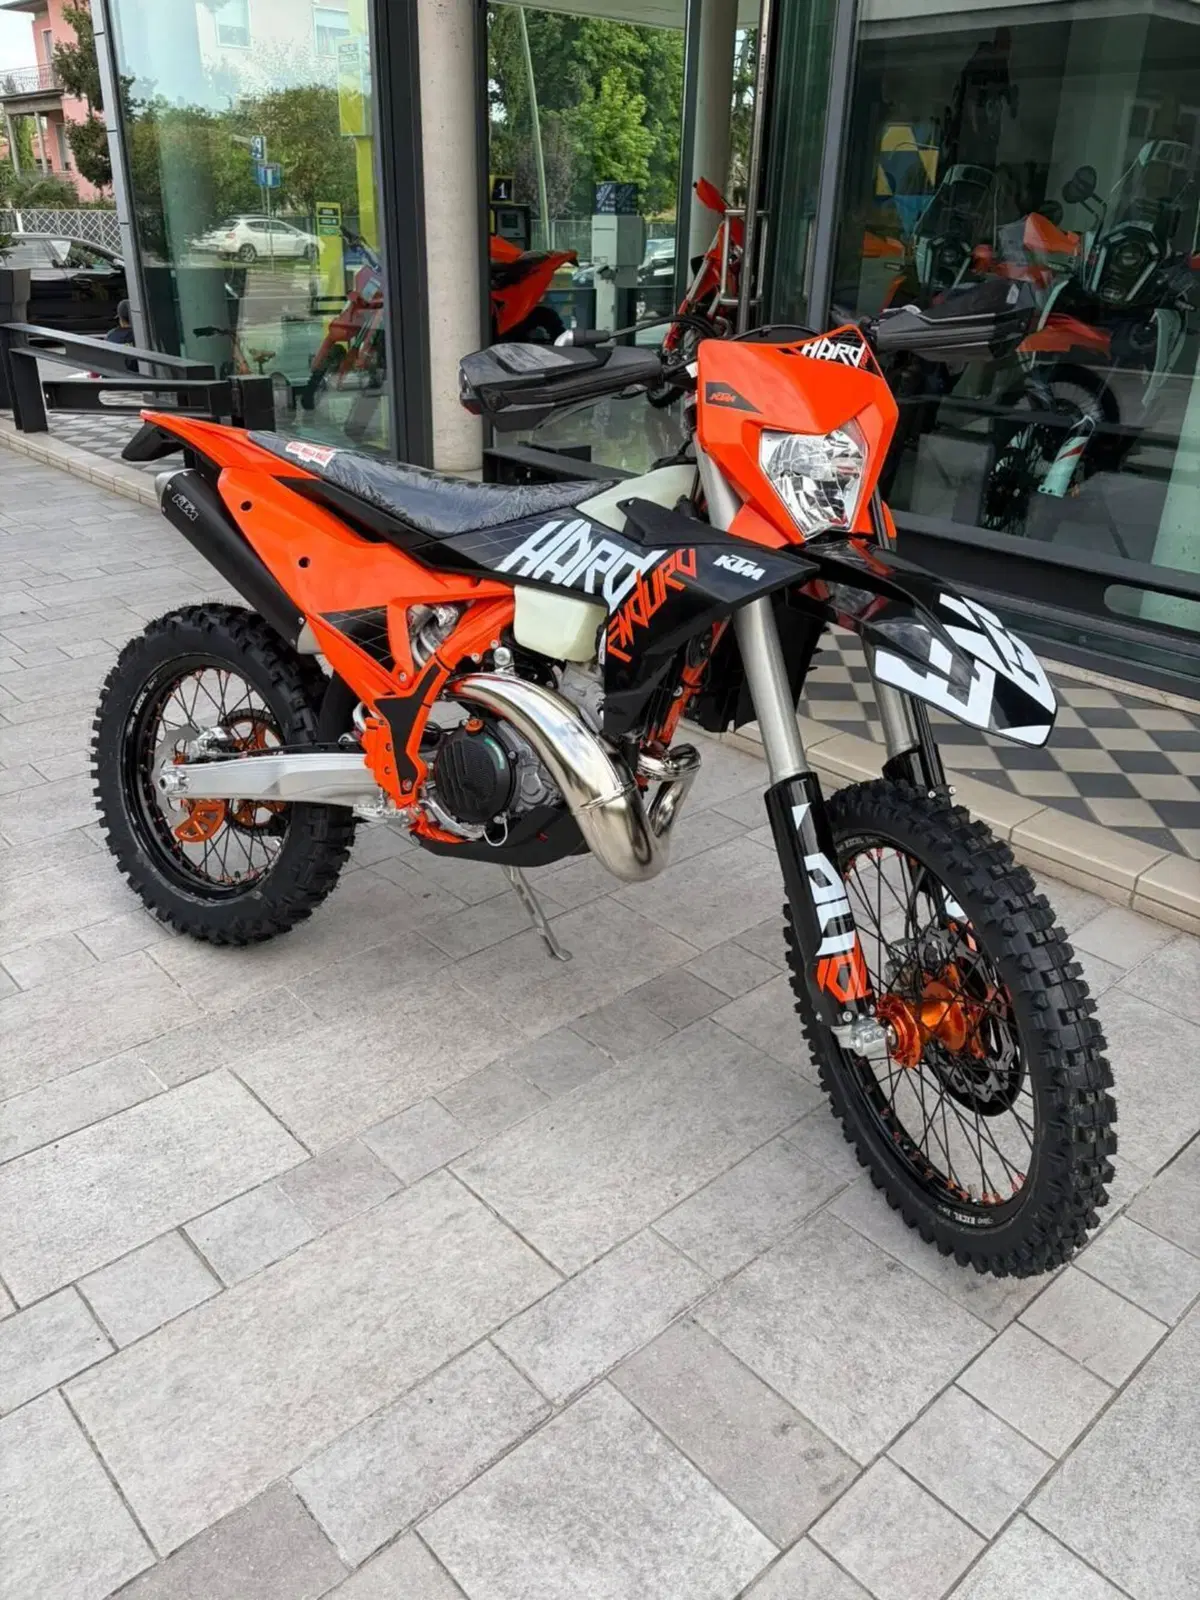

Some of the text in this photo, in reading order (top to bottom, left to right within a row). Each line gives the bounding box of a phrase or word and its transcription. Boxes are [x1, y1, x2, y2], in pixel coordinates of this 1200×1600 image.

[498, 181, 508, 199] 1
[172, 493, 199, 521] KTM
[713, 554, 766, 581] KTM
